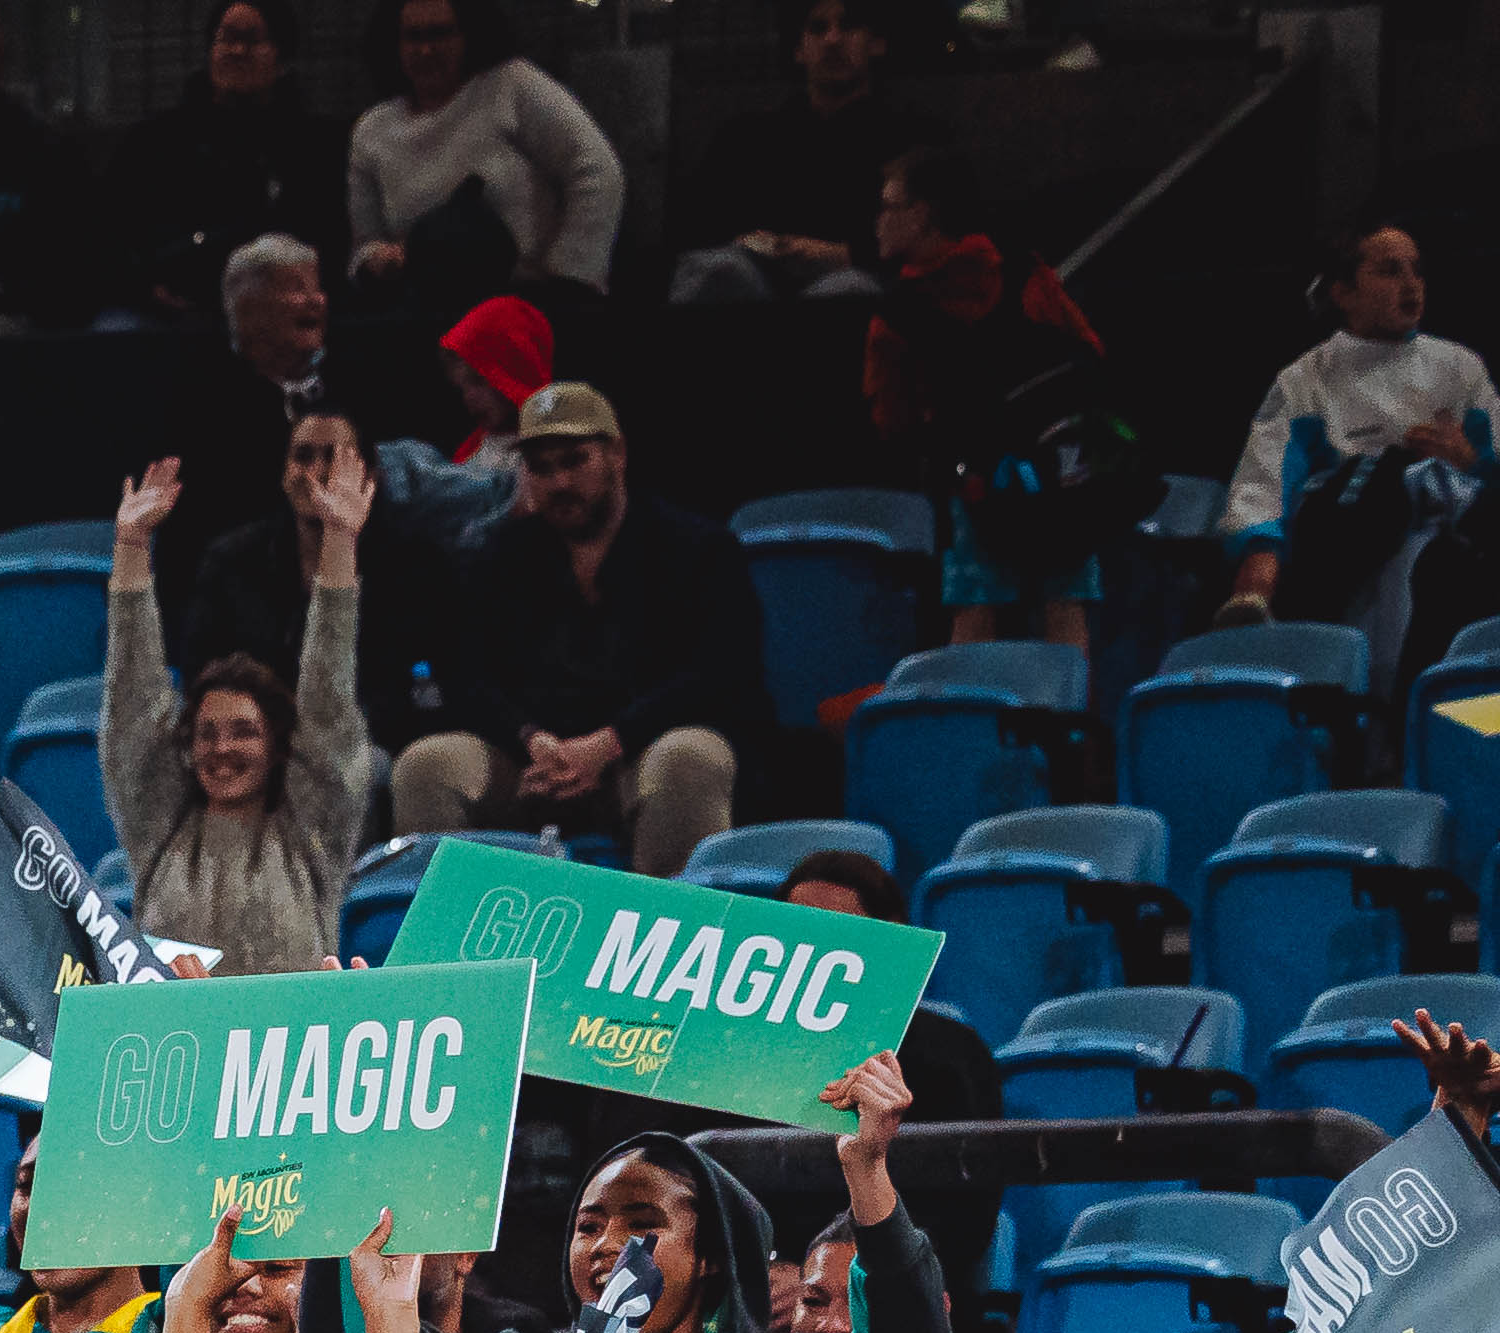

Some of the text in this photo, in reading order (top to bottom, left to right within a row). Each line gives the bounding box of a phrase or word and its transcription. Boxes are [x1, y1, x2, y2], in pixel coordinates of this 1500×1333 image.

[14, 825, 81, 908] GO
[459, 886, 865, 1032] GO MAGIC
[569, 1015, 673, 1059] Magic
[96, 1016, 463, 1146] GO MAGIC
[210, 1172, 302, 1222] Magic
